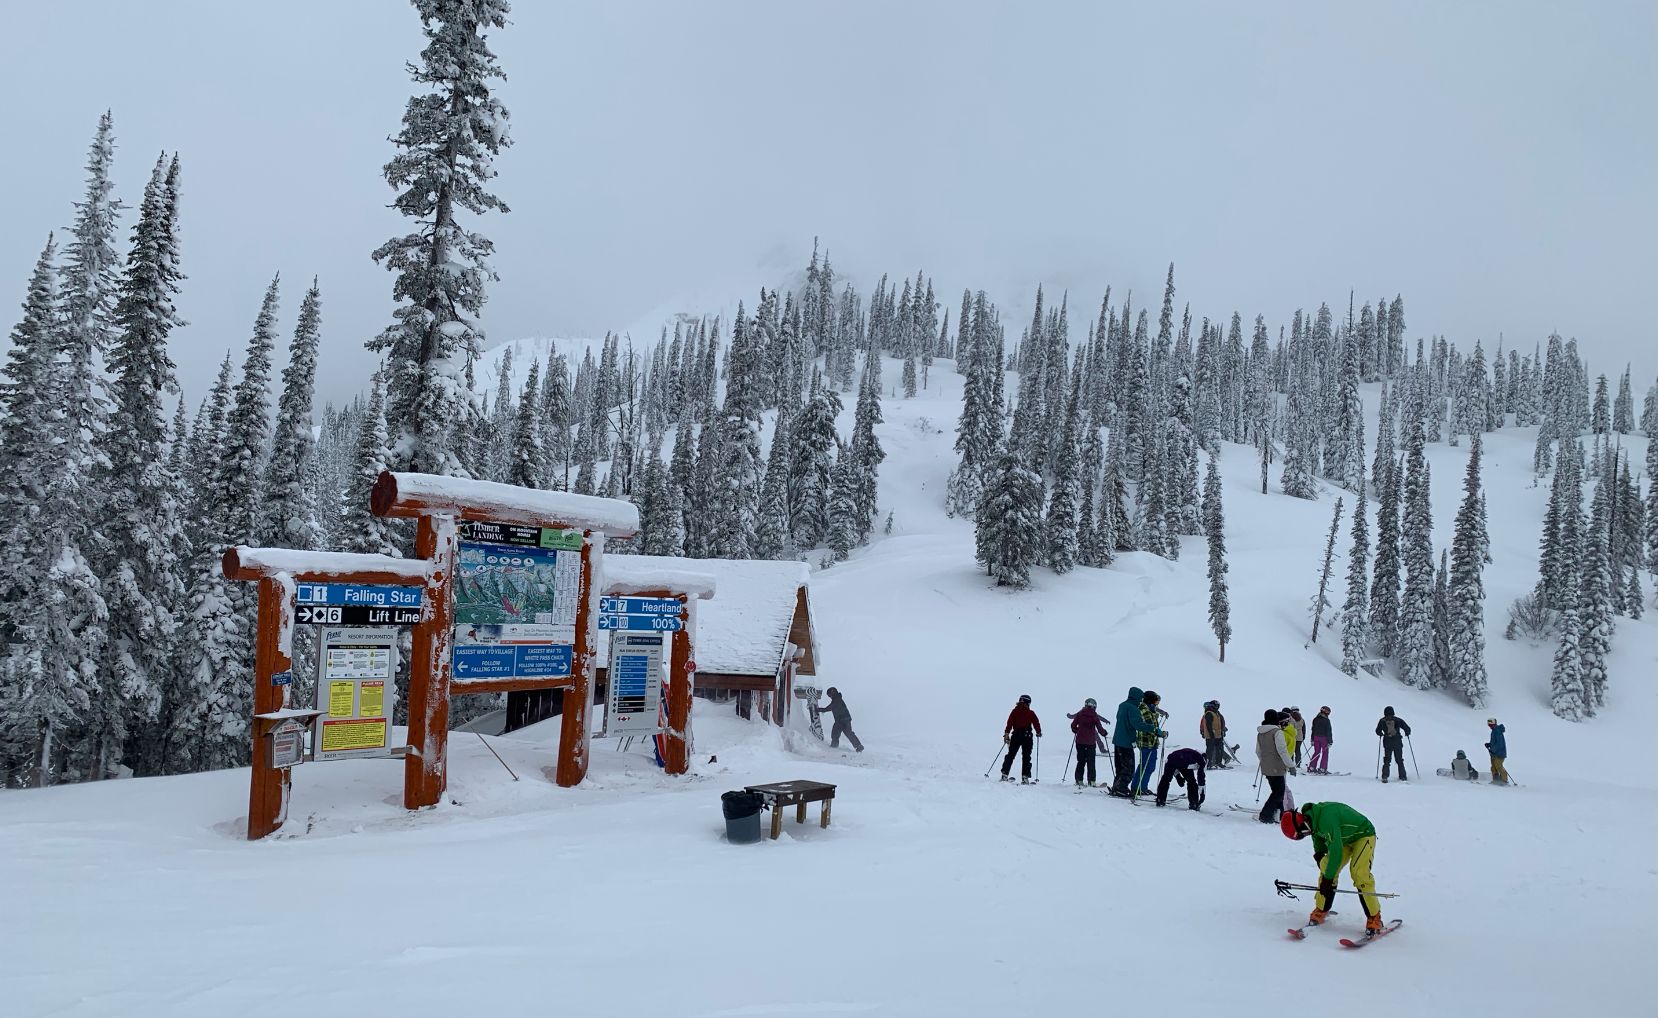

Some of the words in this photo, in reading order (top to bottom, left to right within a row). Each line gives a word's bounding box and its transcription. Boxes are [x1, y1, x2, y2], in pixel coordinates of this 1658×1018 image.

[474, 523, 500, 533] TIMBER
[472, 531, 505, 541] LANDING
[344, 589, 385, 604] Falling
[390, 590, 416, 603] Star
[619, 601, 626, 611] 7
[641, 602, 682, 613] Heartland
[330, 609, 339, 621] 6
[369, 610, 390, 622] Lift
[394, 610, 420, 623] Line
[651, 618, 675, 629] 100%
